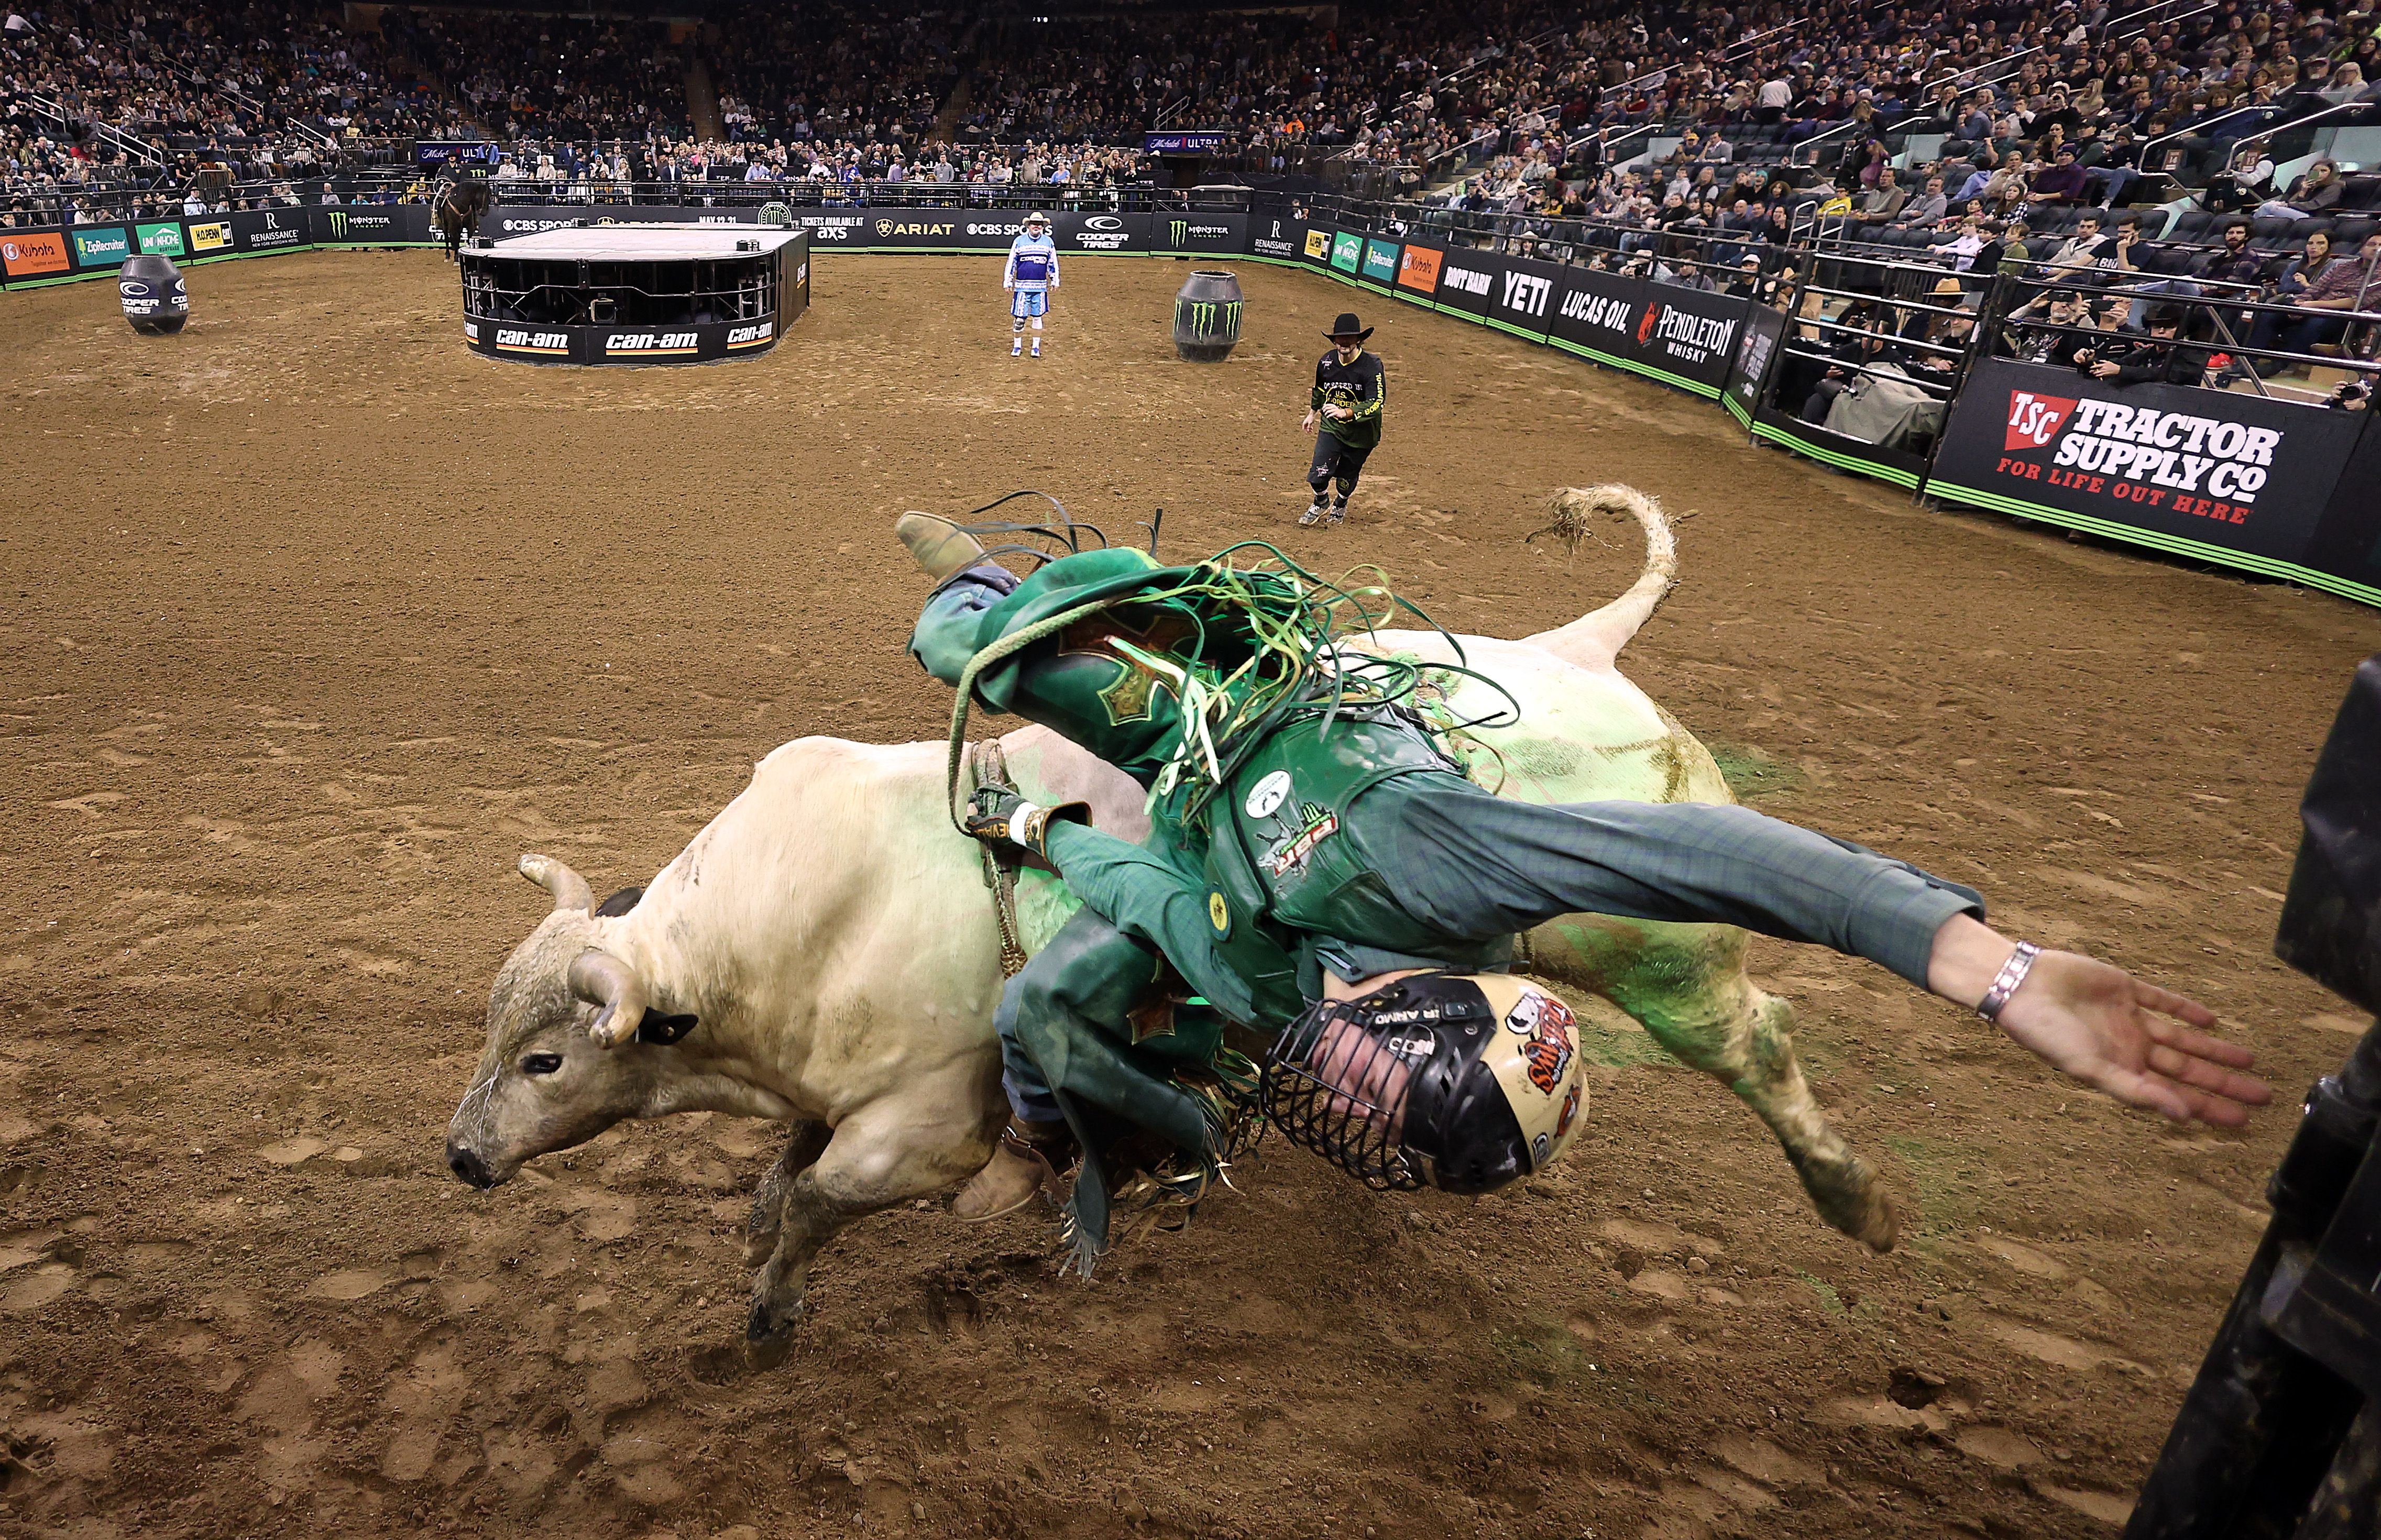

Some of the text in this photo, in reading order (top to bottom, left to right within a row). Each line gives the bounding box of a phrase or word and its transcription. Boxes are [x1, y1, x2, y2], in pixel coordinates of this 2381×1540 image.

[1187, 139, 1219, 148] ULTRA
[349, 216, 390, 225] MONSTER
[513, 219, 572, 231] CBS SPOR
[800, 217, 864, 226] TICKETS AVAILABLE AT
[250, 229, 299, 243] RENAISSANCE
[817, 226, 848, 241] axs
[894, 223, 955, 235] ARIAT
[977, 224, 1053, 236] CBS SPOS
[1188, 226, 1228, 234] MONSTER
[19, 242, 55, 258] Kubota
[85, 239, 126, 255] ZipRecruiter
[1255, 239, 1293, 251] RENAISSANCE
[1411, 256, 1432, 274] Kubota
[1444, 266, 1469, 290] BOOT
[1465, 271, 1493, 296] BARN
[171, 295, 188, 304] COO
[1501, 270, 1553, 317] YETI
[1560, 289, 1631, 332] LUCAS OIL
[496, 329, 568, 348] can-am
[727, 321, 773, 343] can-am
[1656, 304, 1737, 357] PENDLETON
[606, 333, 698, 349] can-am
[1666, 341, 1708, 364] WHISKY
[2009, 392, 2059, 445] TSC
[2072, 398, 2280, 466] TRACTOR
[2053, 433, 2215, 491] SUPPLY
[1996, 457, 2251, 524] FOR LIFE OUT HERE
